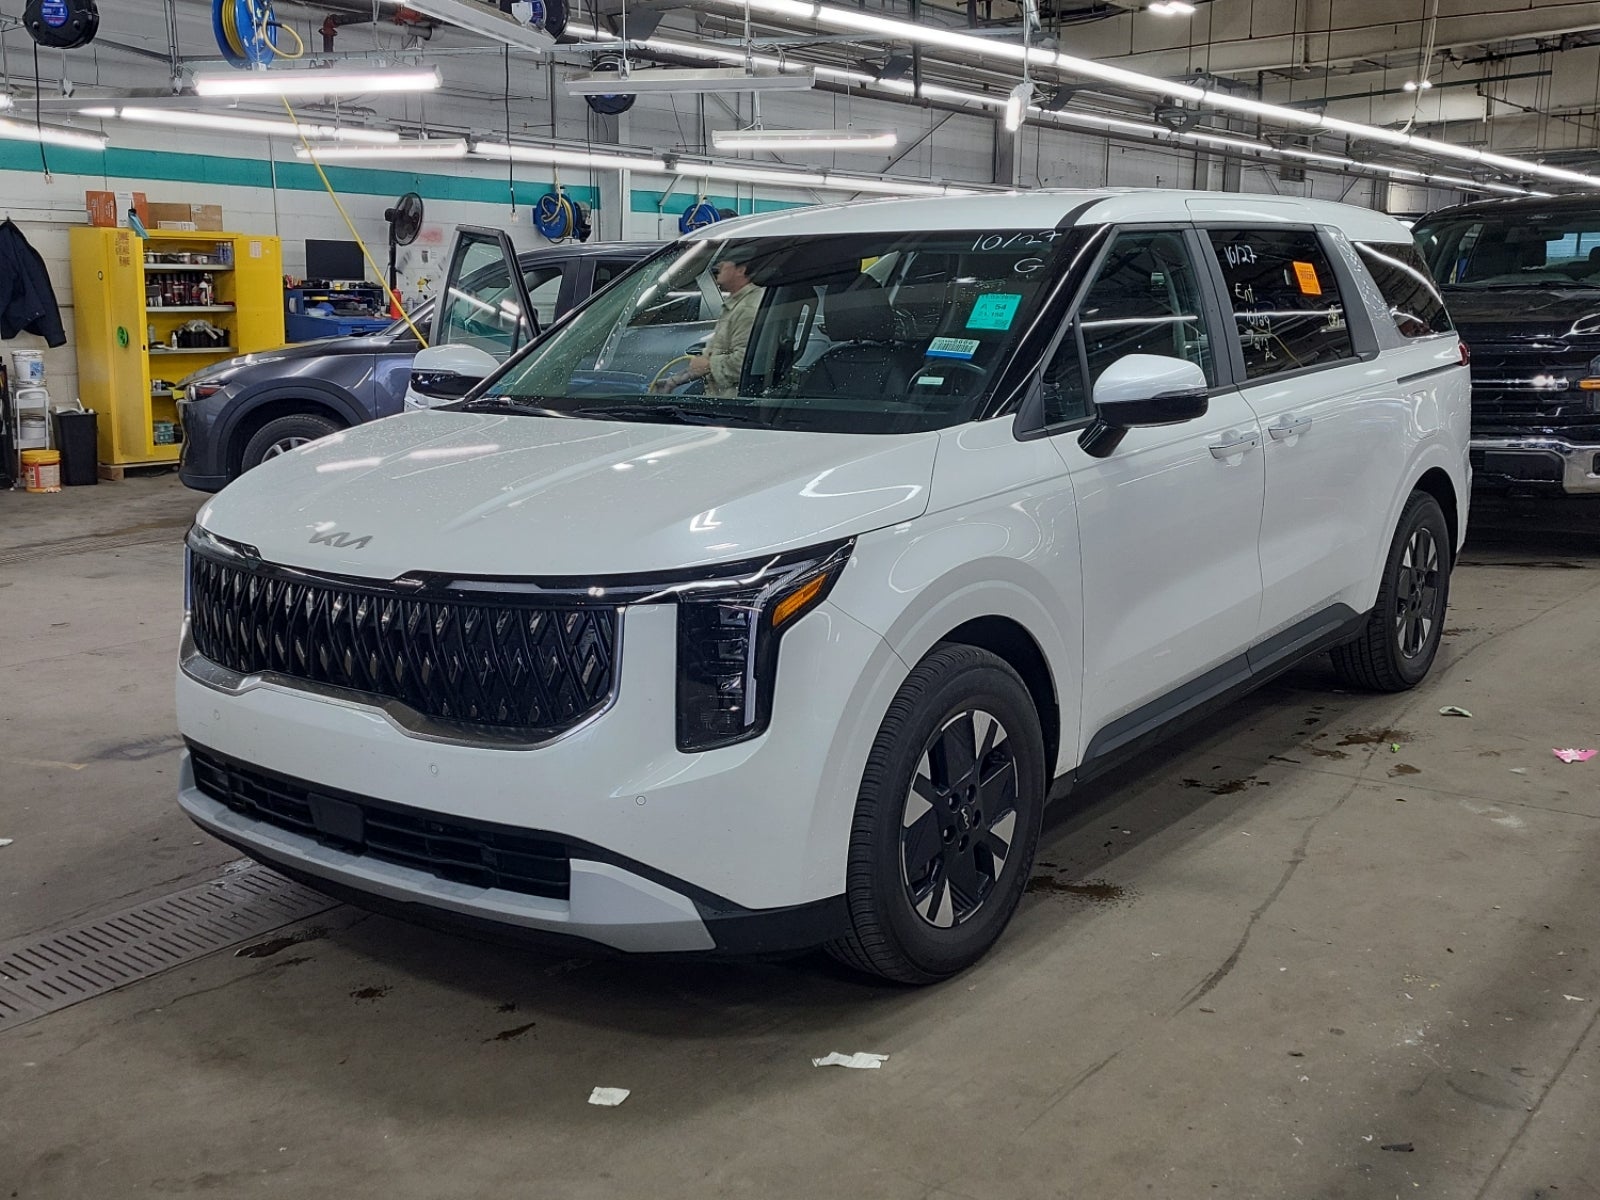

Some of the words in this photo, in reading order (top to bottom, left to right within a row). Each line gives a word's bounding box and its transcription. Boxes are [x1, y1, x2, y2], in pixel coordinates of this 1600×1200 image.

[972, 229, 1062, 252] 10/27
[1013, 257, 1045, 273] G
[1224, 245, 1257, 268] 10/27
